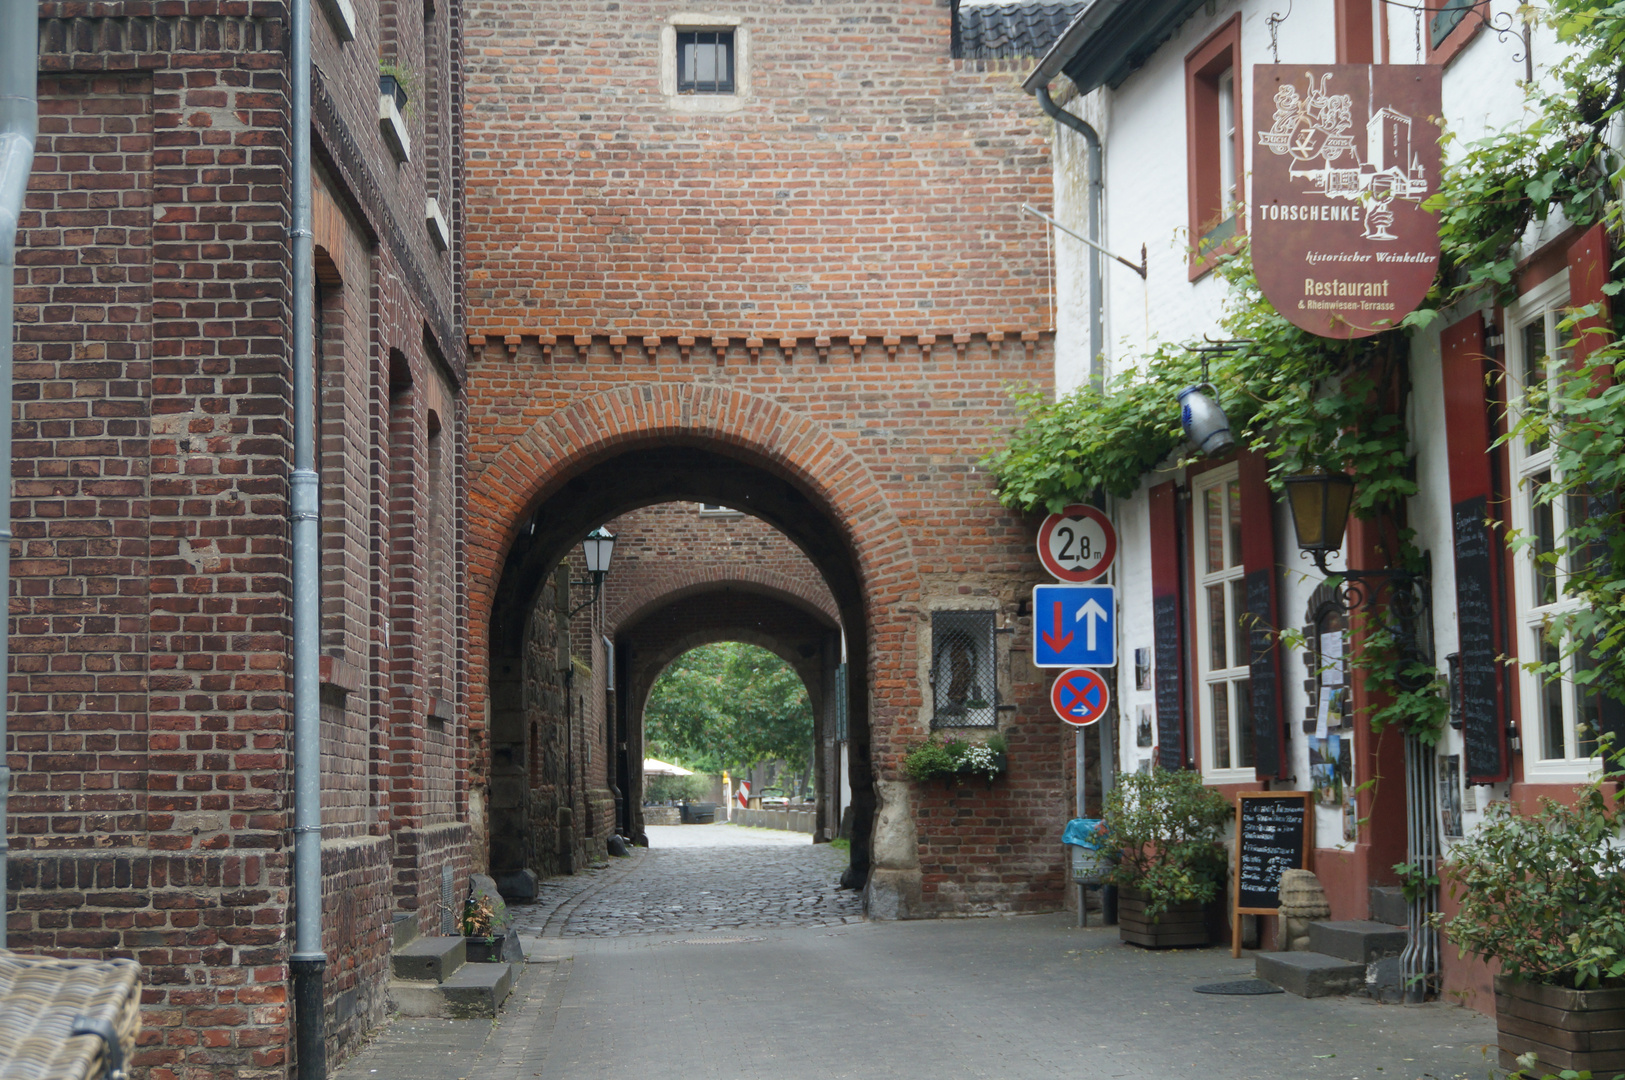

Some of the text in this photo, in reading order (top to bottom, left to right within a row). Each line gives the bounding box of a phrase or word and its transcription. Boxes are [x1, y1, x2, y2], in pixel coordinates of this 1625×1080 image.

[1260, 204, 1360, 221] TORSCHENKE
[1305, 250, 1437, 266] historischer Weinkeller
[1304, 278, 1390, 298] Restaurant
[1297, 299, 1396, 312] & Rheinwiesen-Terrasse
[1057, 526, 1102, 563] 2,8 m
